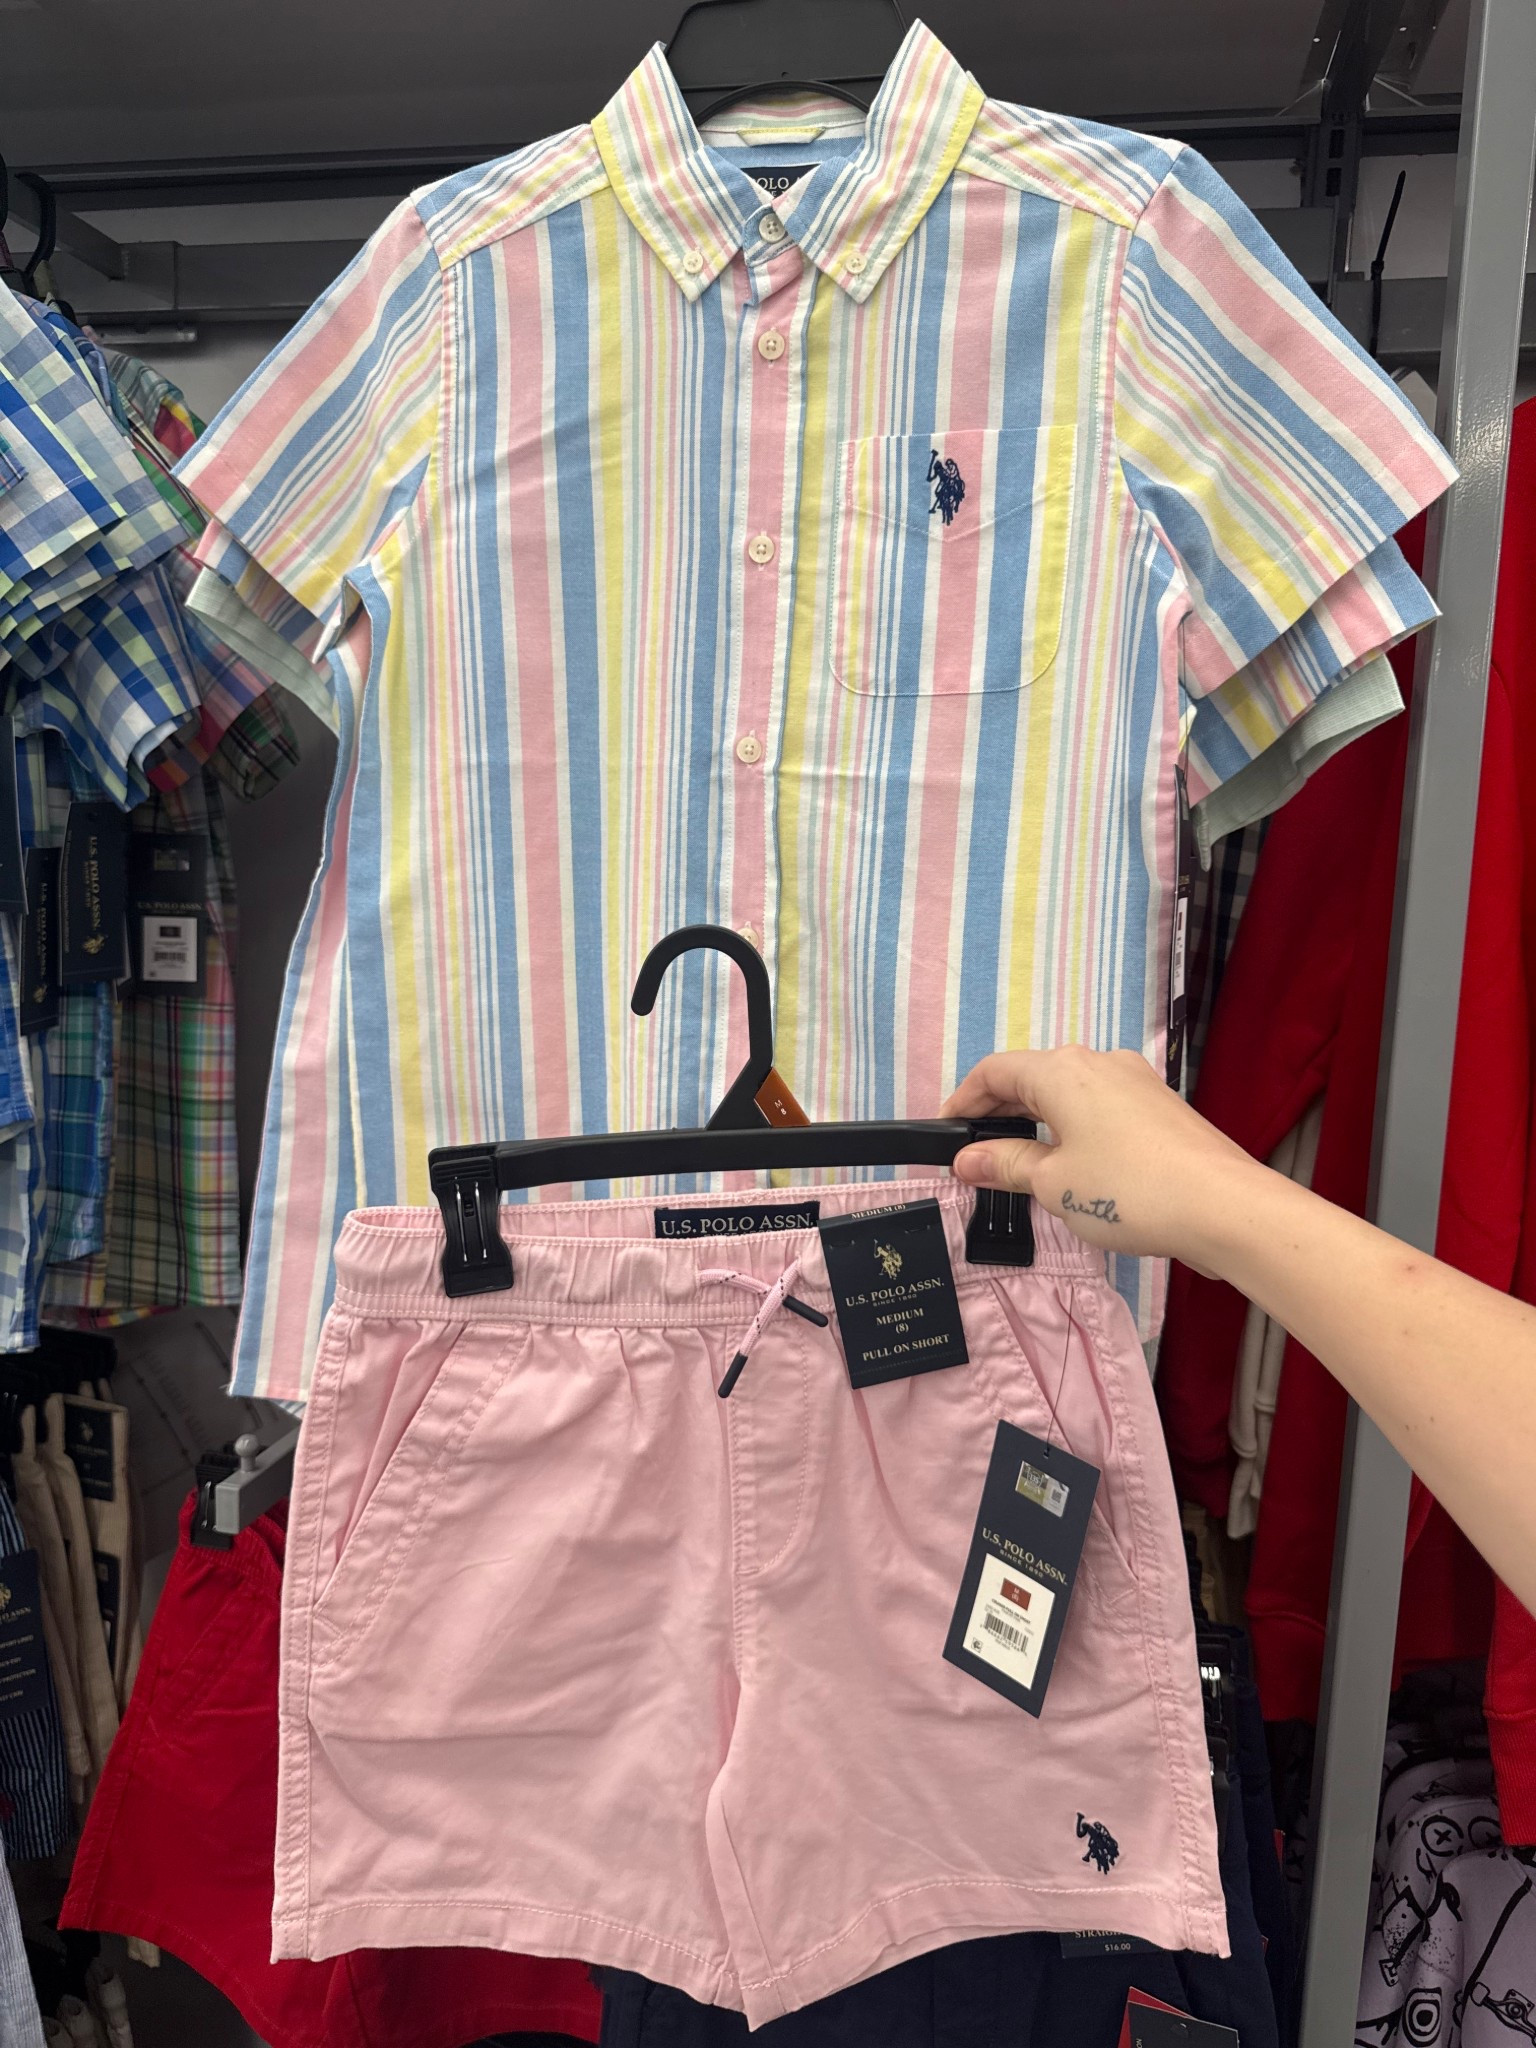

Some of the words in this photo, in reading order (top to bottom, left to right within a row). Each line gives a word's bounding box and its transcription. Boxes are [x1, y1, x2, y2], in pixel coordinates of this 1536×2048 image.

[757, 177, 789, 189] OLO
[852, 1207, 892, 1219] MEDIUM
[662, 1219, 696, 1236] U.S.
[700, 1216, 754, 1234] POLO
[760, 1212, 814, 1229] ASSN.
[846, 1294, 868, 1306] U.S.
[871, 1286, 905, 1301] POLO
[908, 1278, 944, 1293] ASSN.
[876, 1308, 924, 1325] MEDIUM
[896, 1323, 909, 1334] (8)
[862, 1348, 891, 1361] PULL
[894, 1342, 910, 1353] ON
[912, 1334, 949, 1349] SHORT
[983, 1528, 1001, 1546] U.S.
[1004, 1539, 1034, 1563] POLO
[1036, 1559, 1067, 1585] ASSN.
[1104, 1942, 1131, 1951] $16.00
